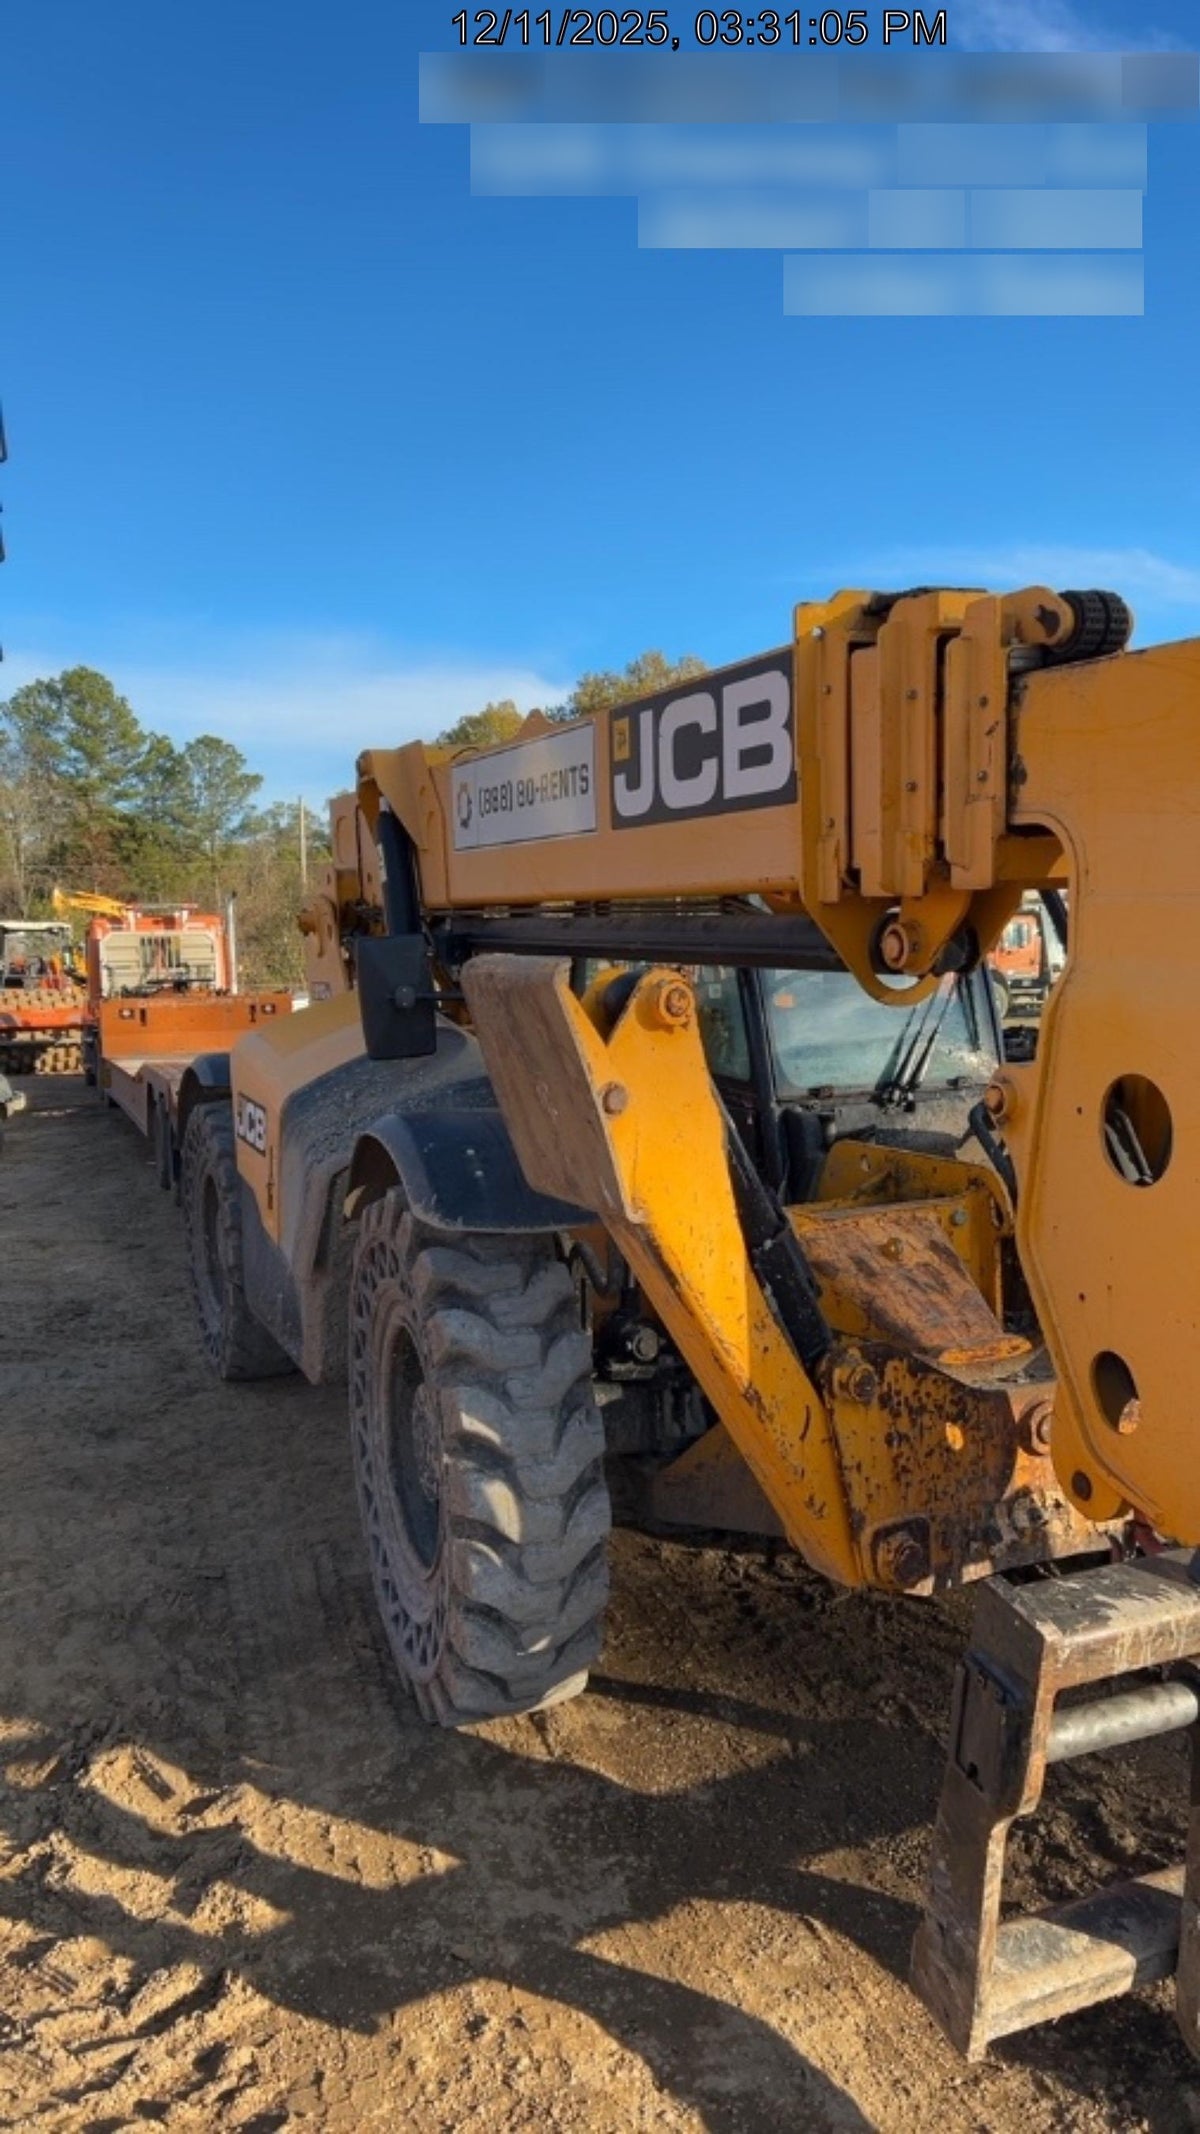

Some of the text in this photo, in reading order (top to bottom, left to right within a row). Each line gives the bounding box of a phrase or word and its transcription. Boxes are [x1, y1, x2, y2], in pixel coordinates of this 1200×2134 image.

[613, 670, 795, 818] JCB
[478, 780, 513, 818] (888)
[237, 1098, 266, 1152] JCB
